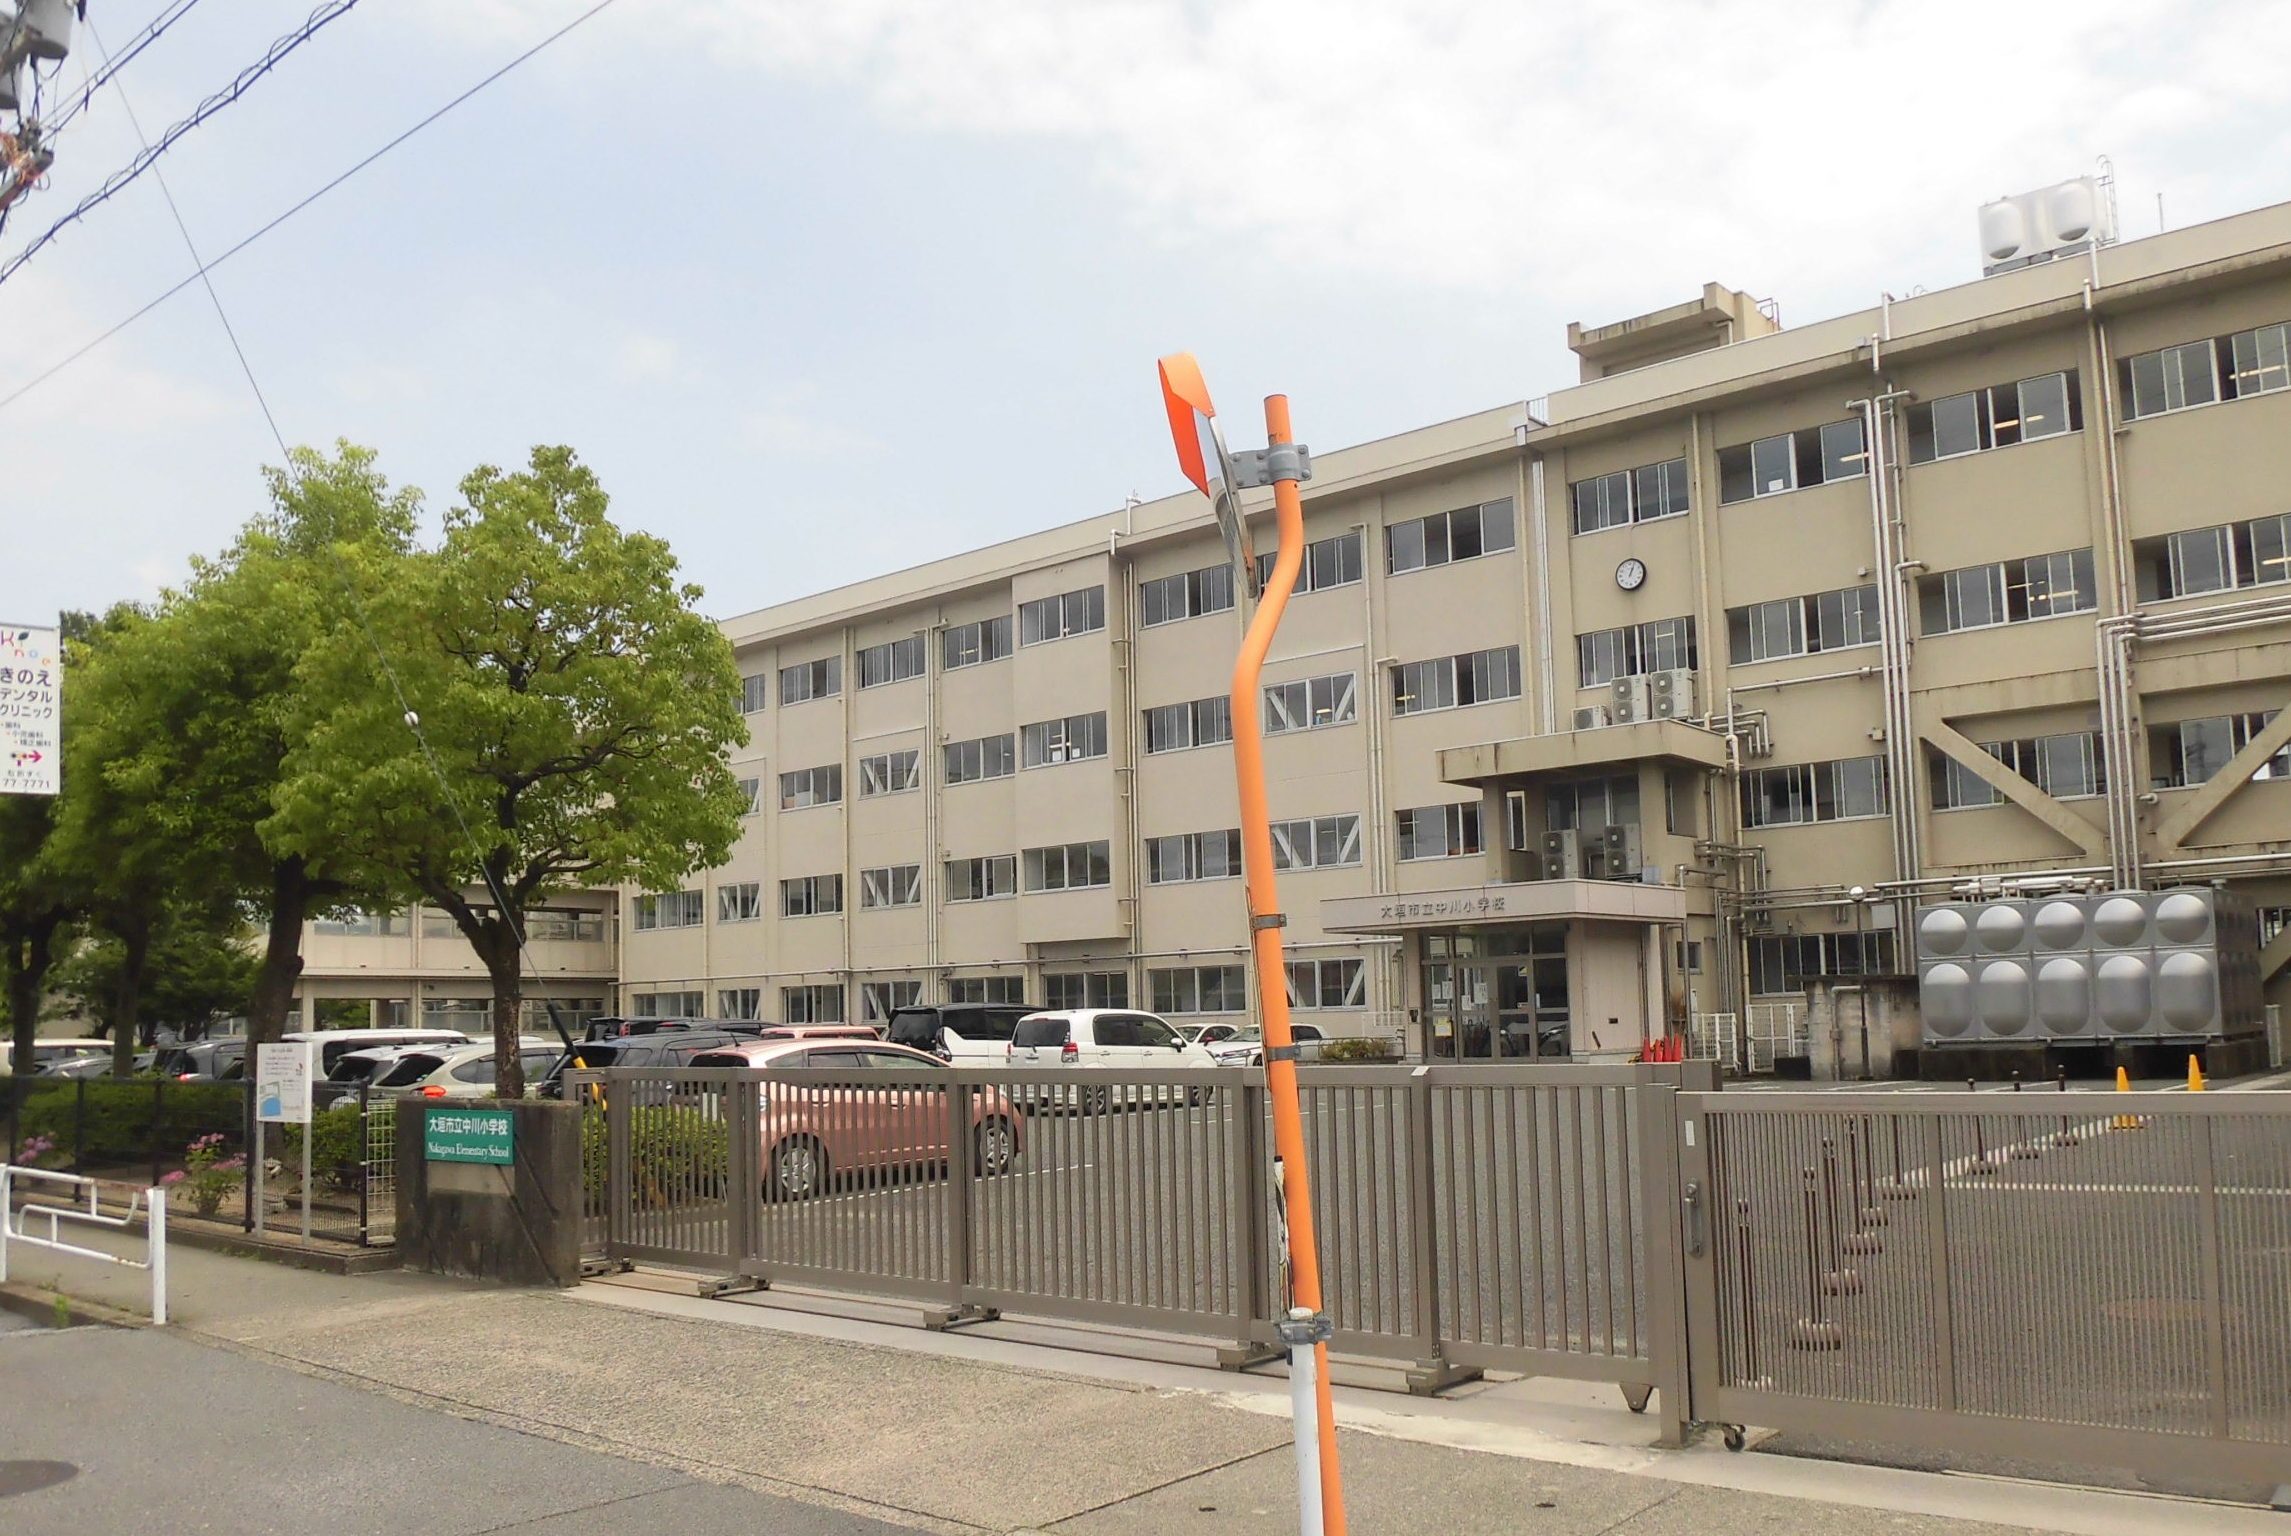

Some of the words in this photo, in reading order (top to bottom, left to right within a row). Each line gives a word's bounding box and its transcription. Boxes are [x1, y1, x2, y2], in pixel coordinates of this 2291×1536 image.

[0, 688, 53, 704] デンタル
[0, 703, 52, 719] クリニック
[1381, 897, 1505, 918] 大垣市立中川小学校
[429, 1116, 508, 1135] 大垣市立中川小学校
[456, 1143, 488, 1160] Elementary
[488, 1145, 509, 1157] School
